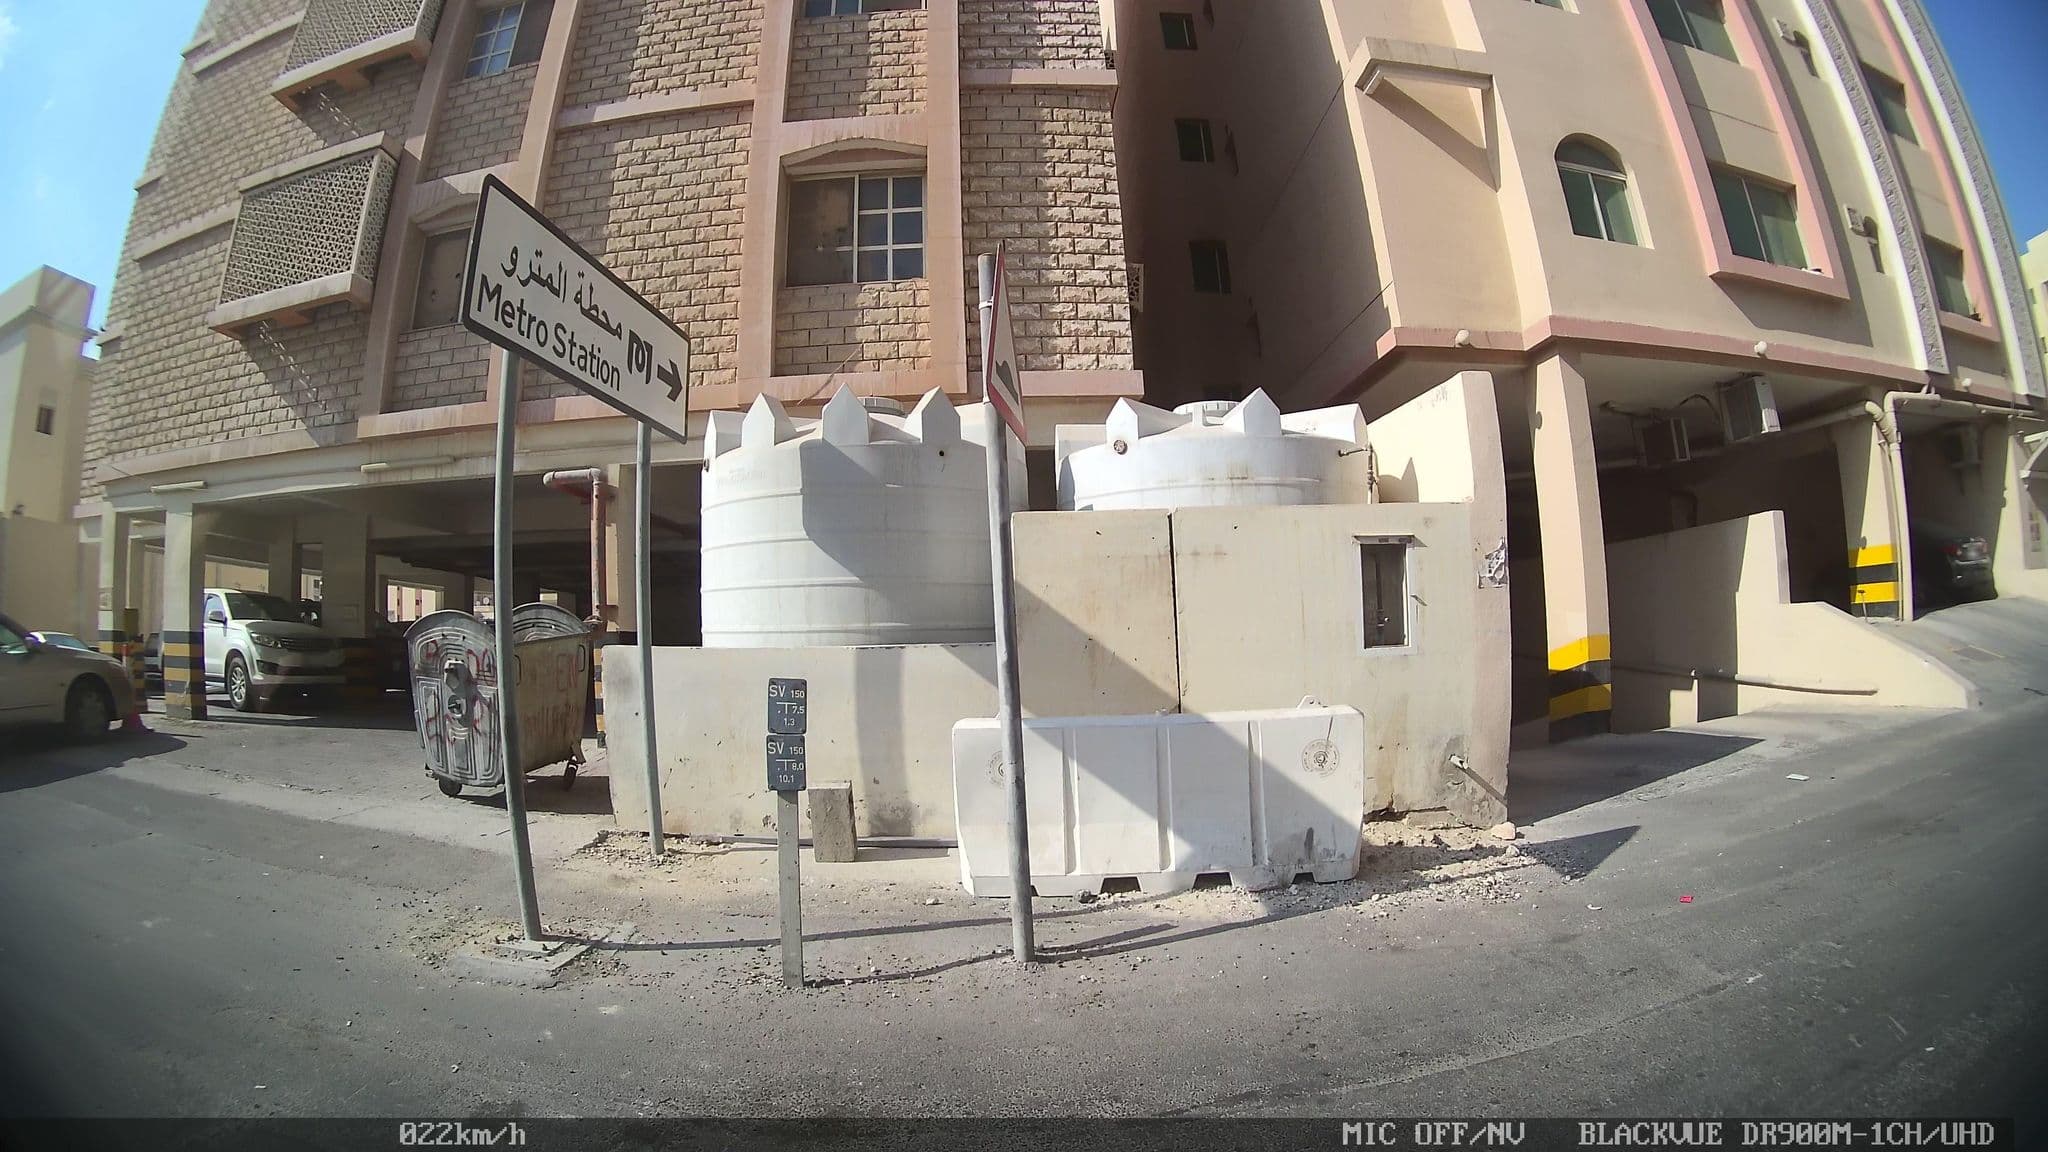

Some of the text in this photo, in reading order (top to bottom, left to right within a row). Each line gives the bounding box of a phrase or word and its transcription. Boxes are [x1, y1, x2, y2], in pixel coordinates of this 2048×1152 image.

[500, 245, 624, 342] محطة المترو
[476, 273, 621, 392] Metro Station
[769, 684, 805, 699] SV 150
[783, 717, 795, 726] 1.3
[767, 742, 804, 755] SV 150
